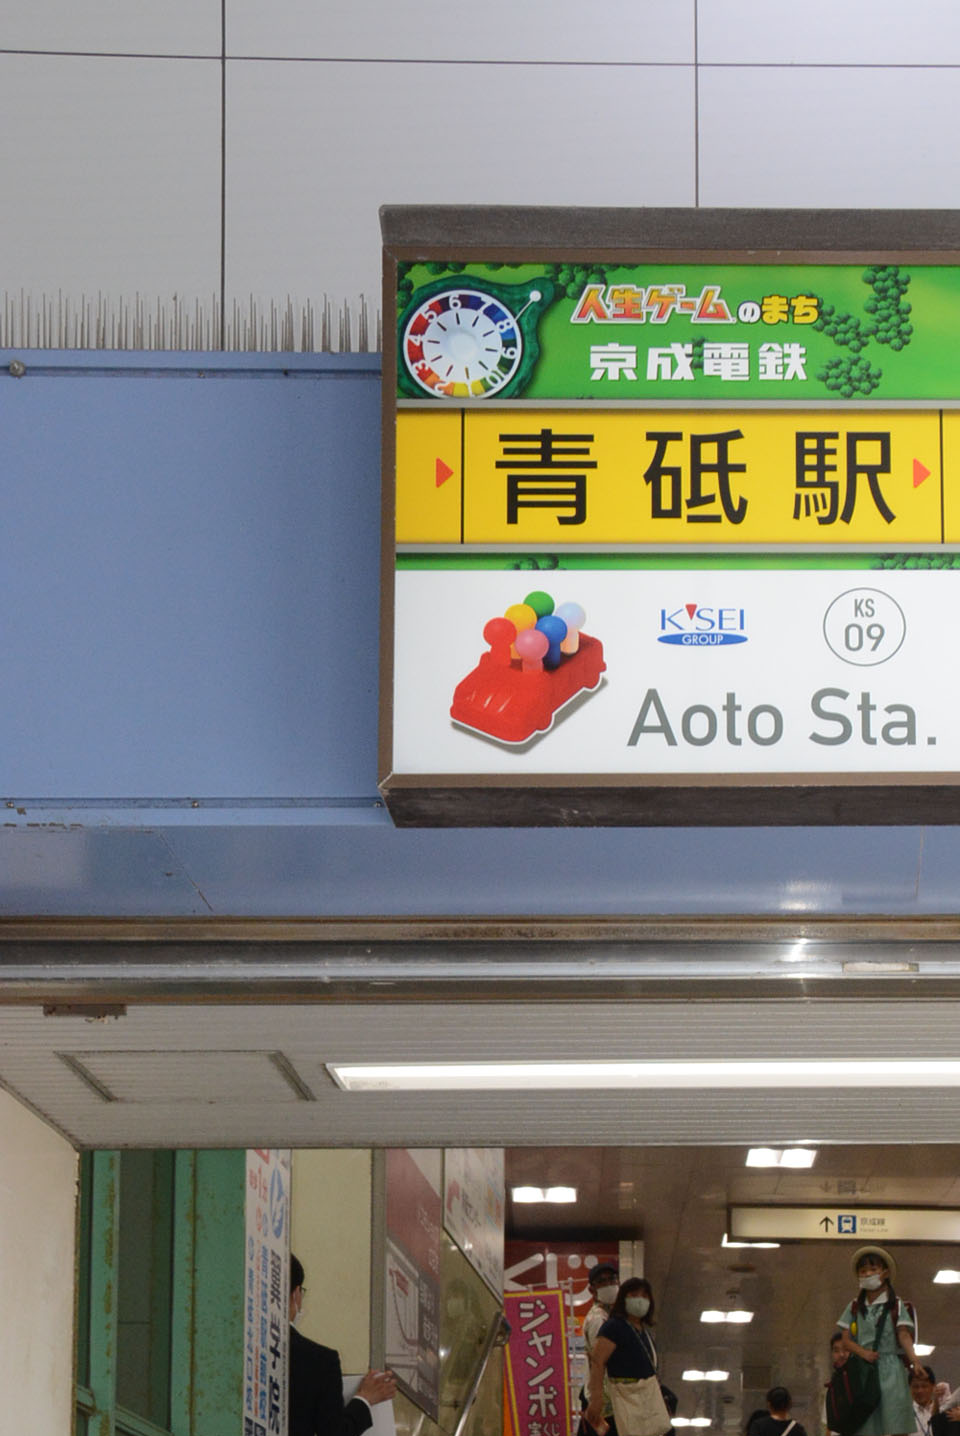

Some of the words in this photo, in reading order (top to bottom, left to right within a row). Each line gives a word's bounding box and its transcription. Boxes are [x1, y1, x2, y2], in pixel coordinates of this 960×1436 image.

[570, 284, 820, 324] 人生ゲームのまち
[590, 342, 808, 382] 京成電鉄
[495, 429, 897, 526] 青砥駅
[854, 598, 875, 618] KS
[682, 634, 724, 646] GROUP
[844, 623, 885, 652] 09
[626, 688, 784, 747] Aoto
[808, 687, 937, 747] Sta.
[519, 1299, 558, 1418] ジャンボ
